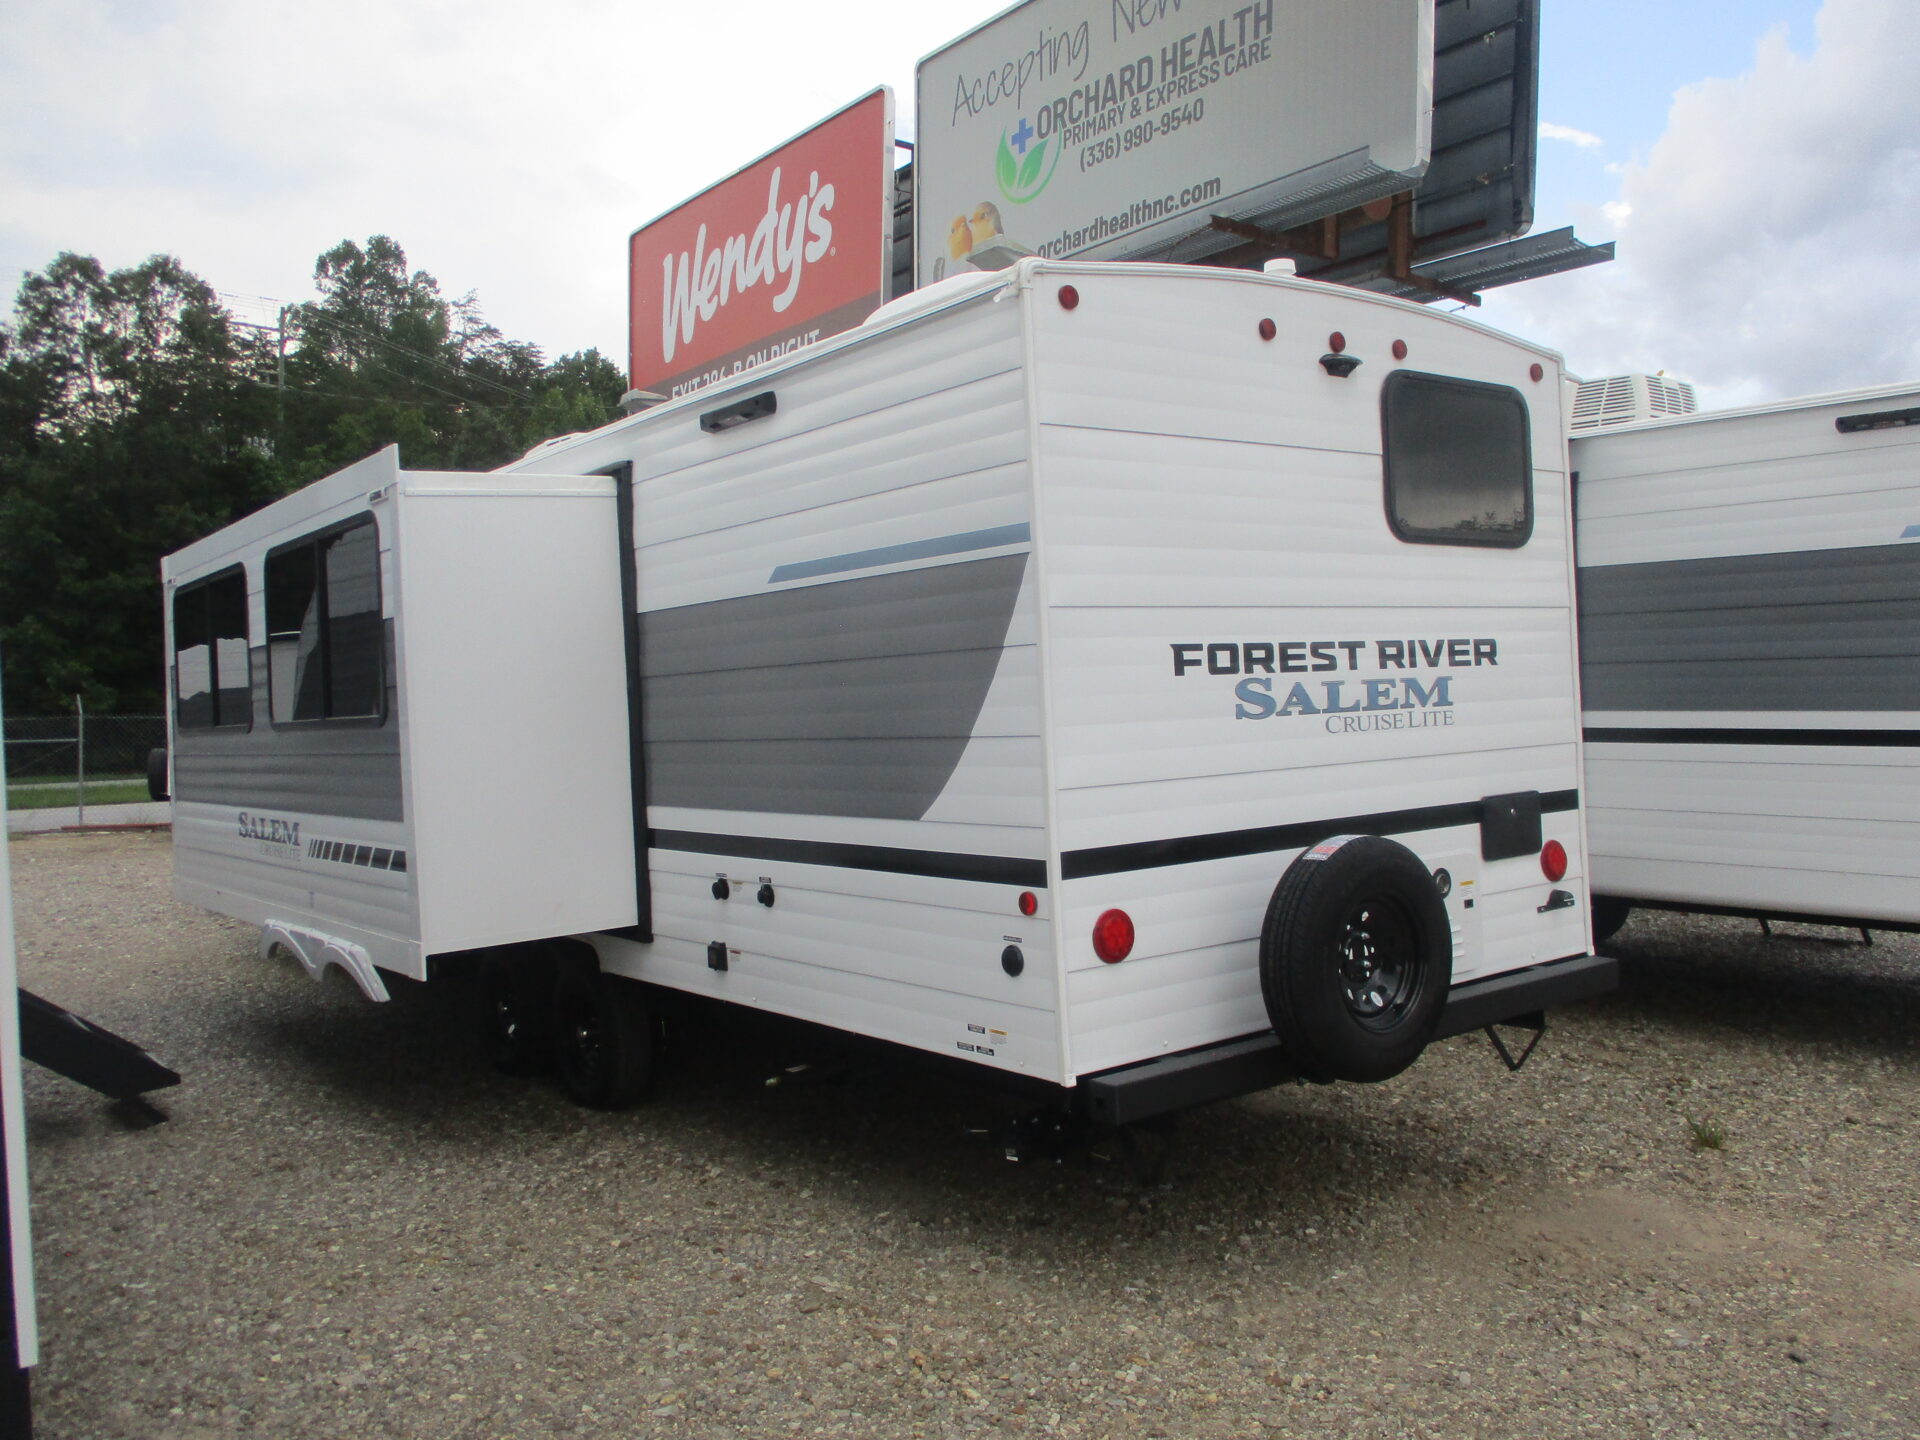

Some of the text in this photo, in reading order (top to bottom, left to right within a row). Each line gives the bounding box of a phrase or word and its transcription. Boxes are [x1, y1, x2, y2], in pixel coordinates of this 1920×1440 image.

[952, 20, 1089, 127] Accepting
[1036, 0, 1273, 139] ORCHARD HEALTH
[1063, 35, 1272, 150] PRIMARY & EXPRESS CARE
[1080, 98, 1204, 172] (336) 990-9540
[1037, 177, 1221, 259] orchardhealthnc.com
[662, 166, 835, 364] Wendy's
[1169, 638, 1499, 677] FOREST RIVER
[1234, 676, 1454, 721] SALEM
[239, 811, 301, 847] SALEM
